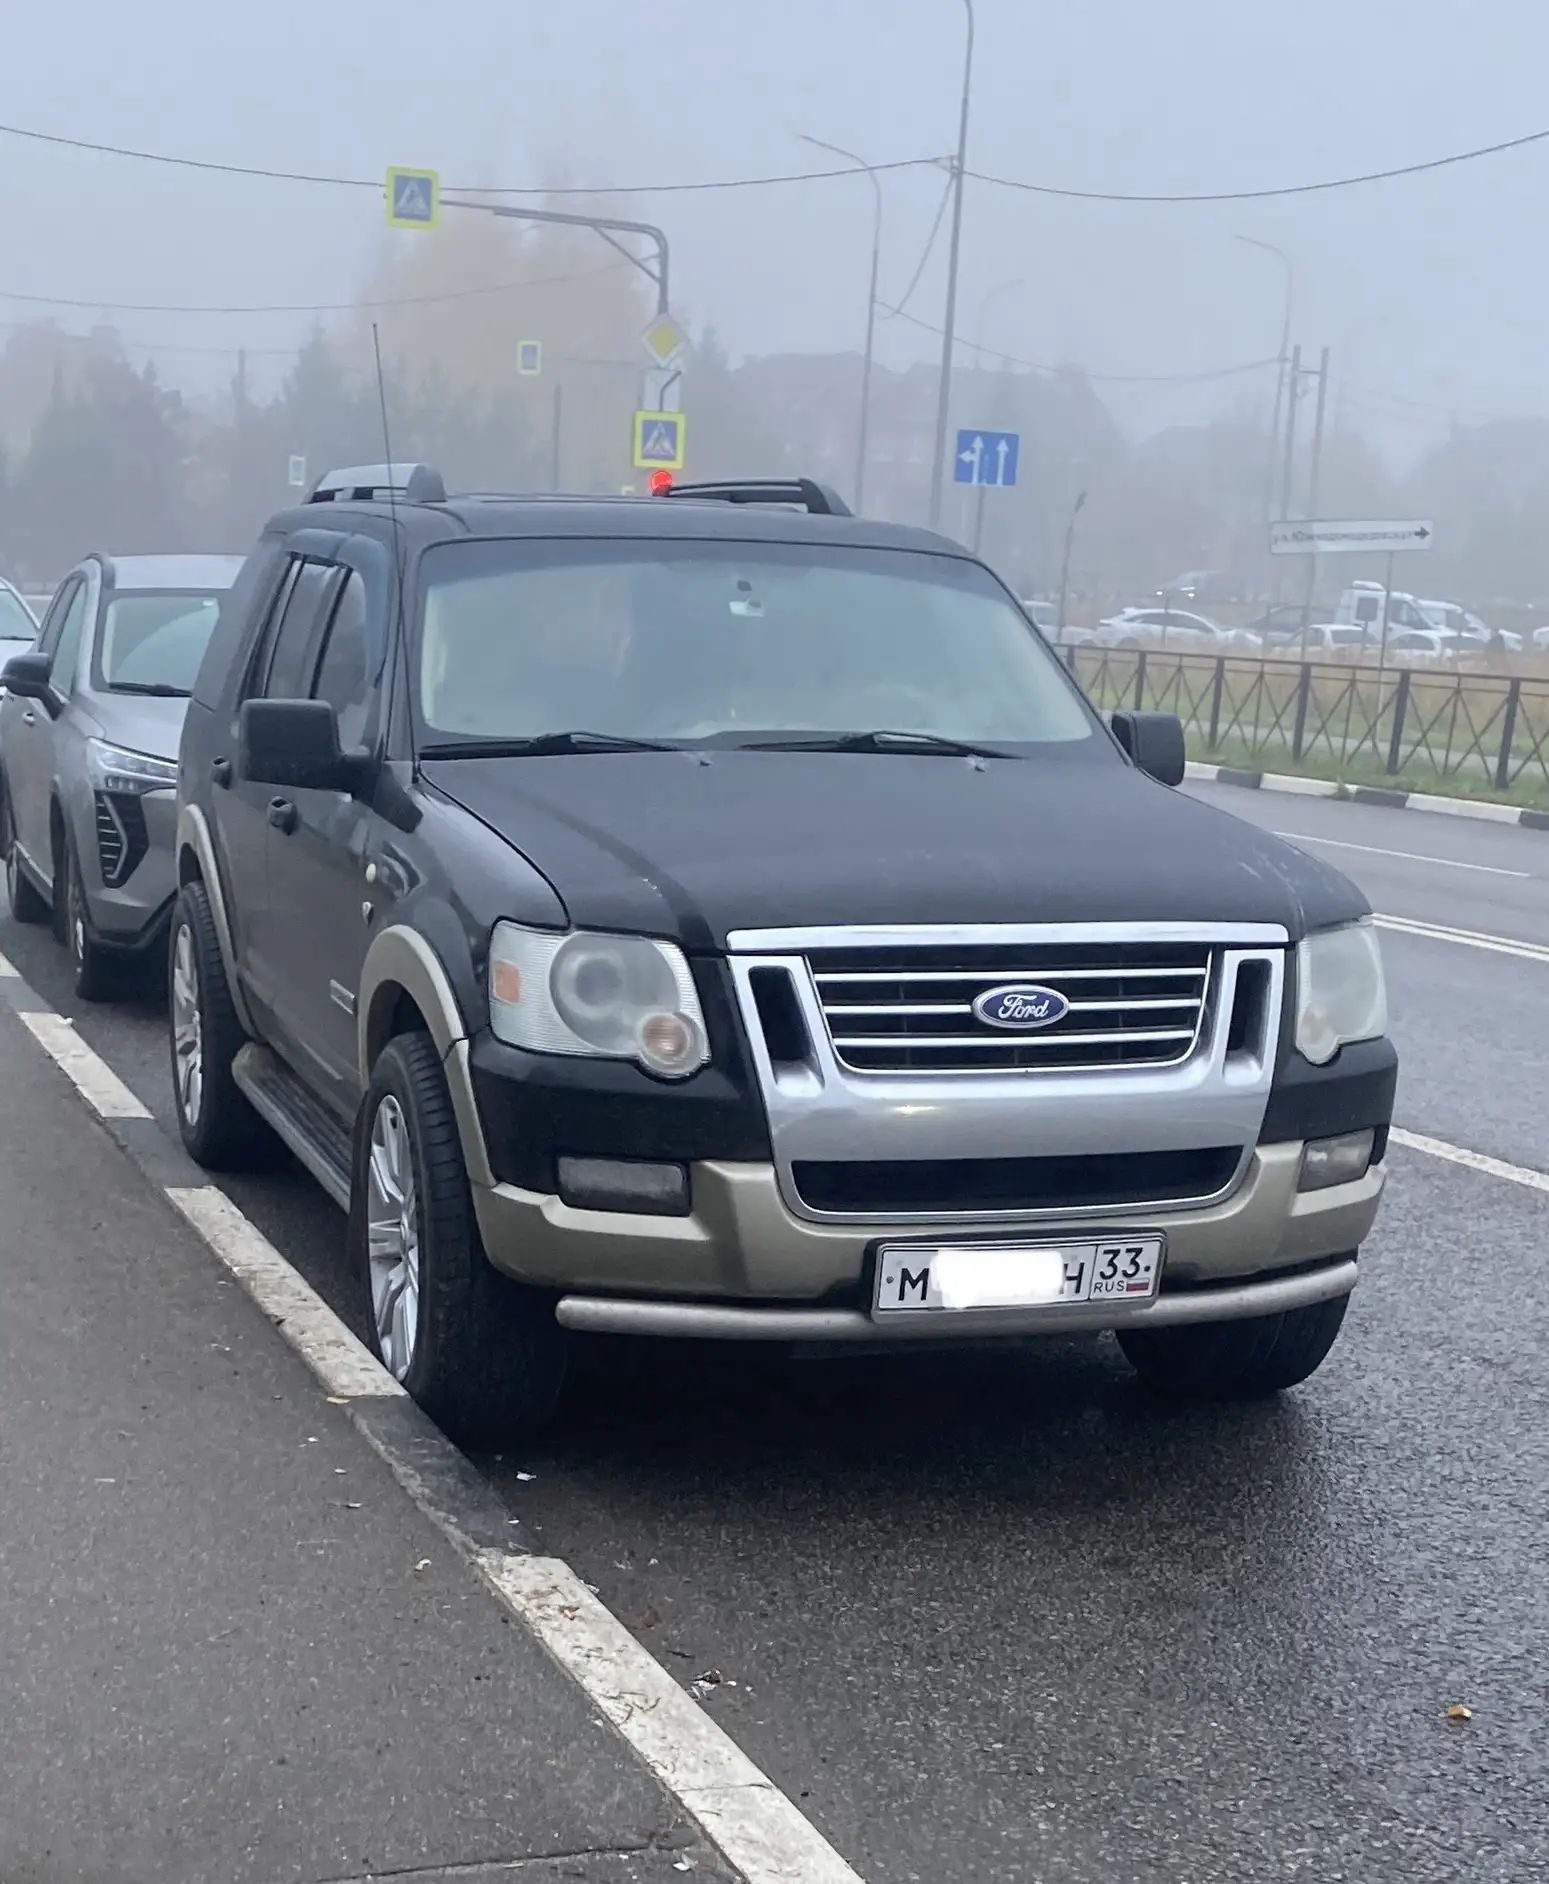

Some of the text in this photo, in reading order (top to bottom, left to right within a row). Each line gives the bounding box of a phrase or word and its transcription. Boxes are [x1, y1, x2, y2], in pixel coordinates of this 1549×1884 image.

[998, 994, 1049, 1019] Ford
[1100, 1247, 1143, 1280] 33
[1094, 1280, 1125, 1293] RUS
